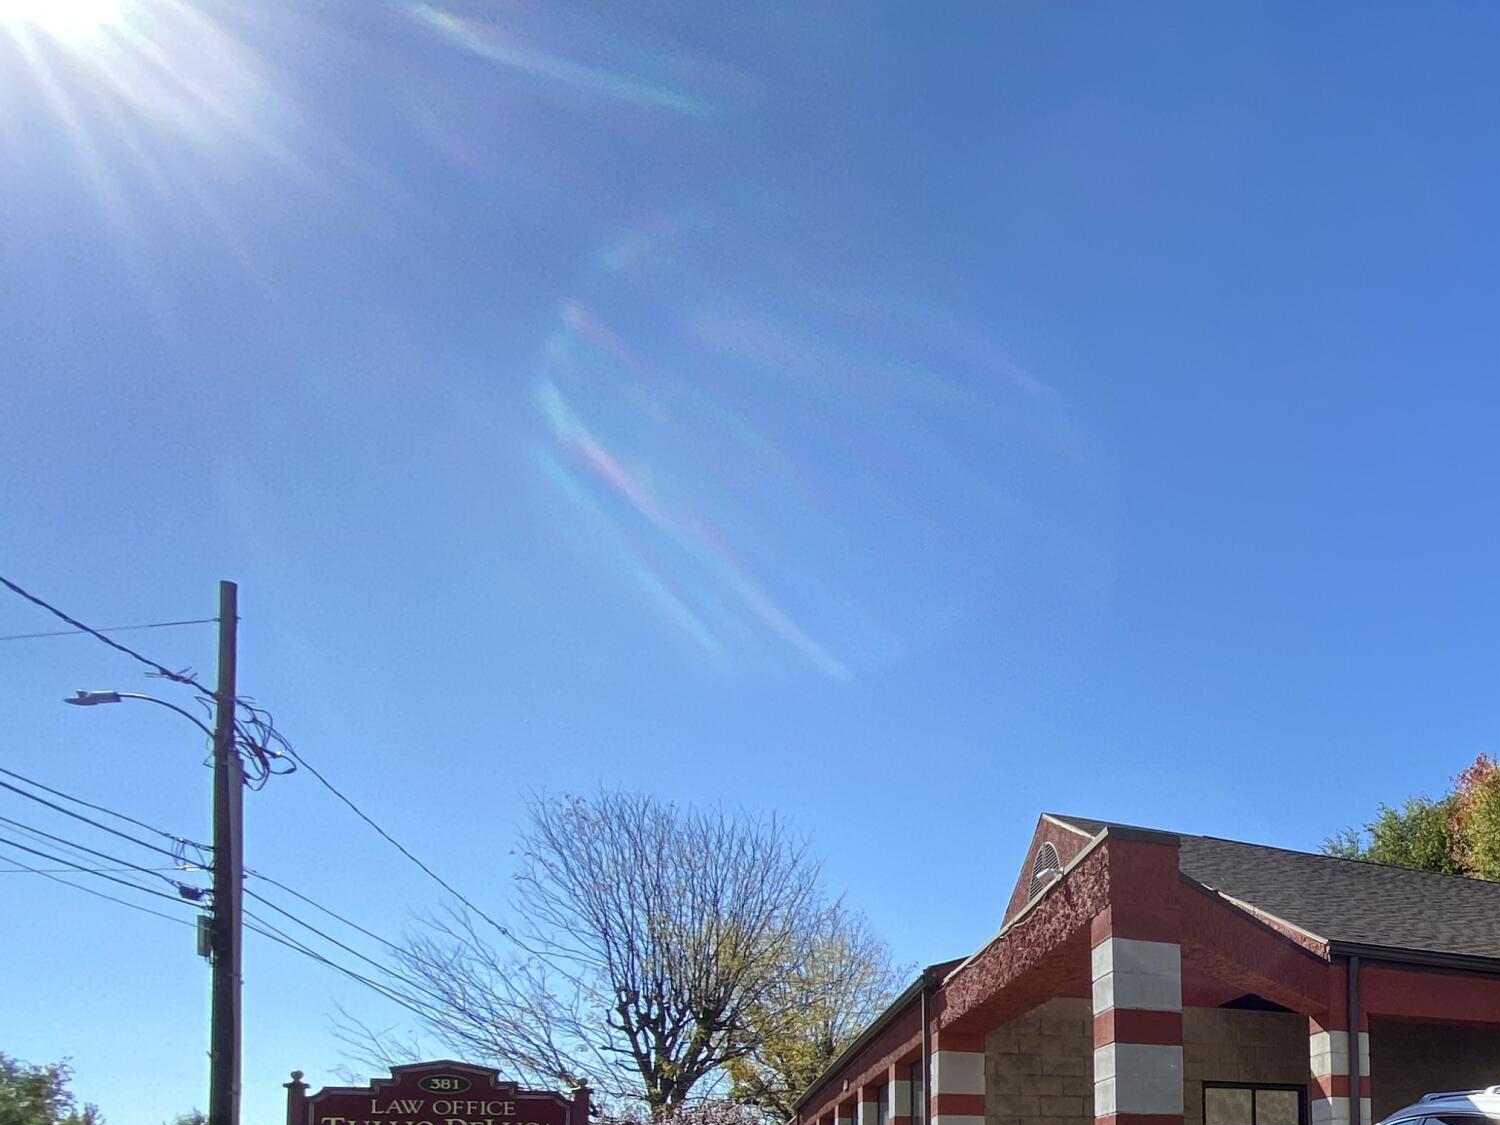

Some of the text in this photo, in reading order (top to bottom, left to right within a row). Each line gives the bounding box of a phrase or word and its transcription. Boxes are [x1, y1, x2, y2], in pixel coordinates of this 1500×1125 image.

[430, 1078, 460, 1090] 381
[370, 1099, 516, 1116] LAW OFFICE
